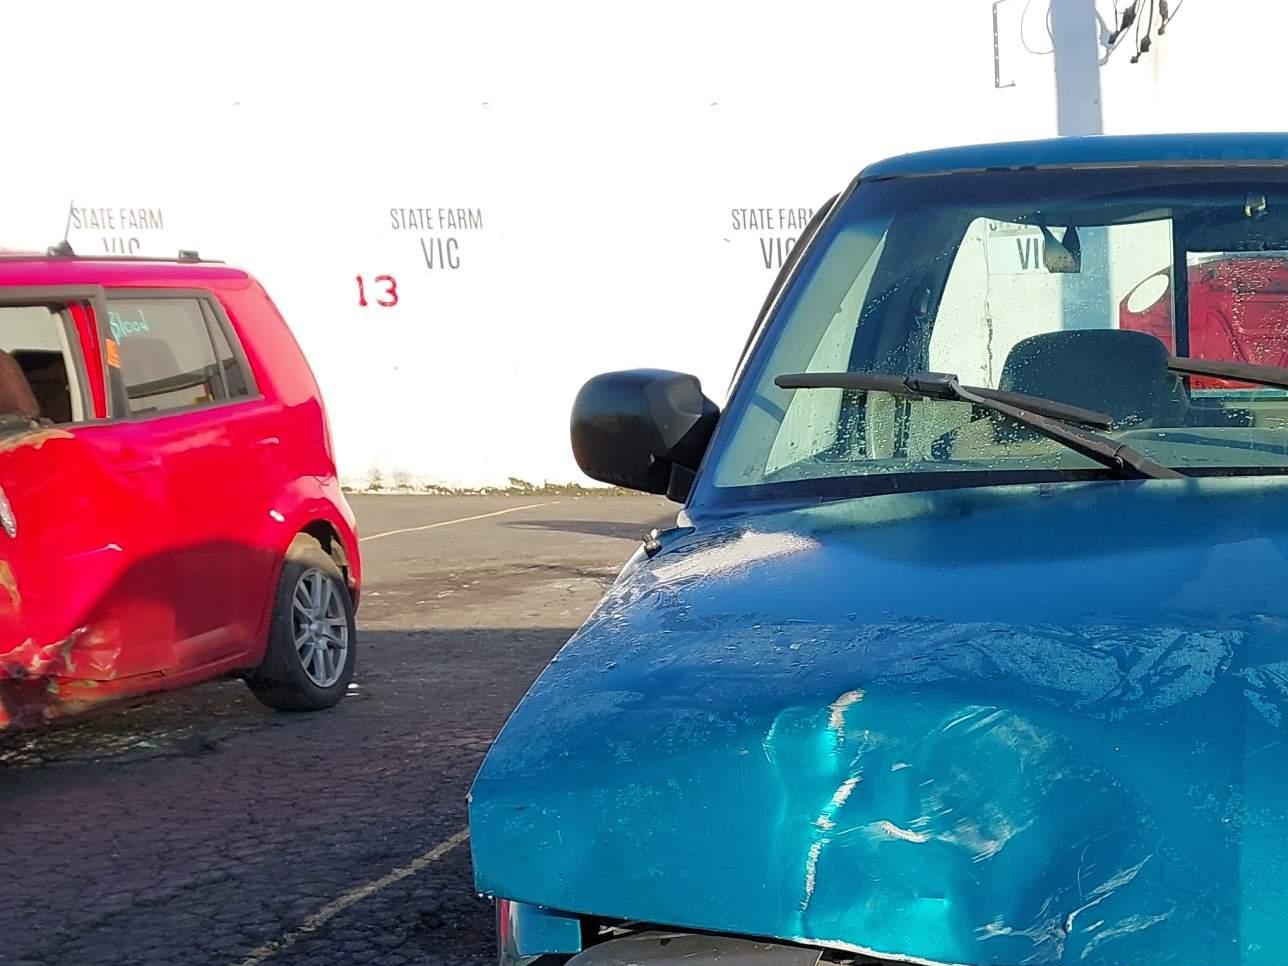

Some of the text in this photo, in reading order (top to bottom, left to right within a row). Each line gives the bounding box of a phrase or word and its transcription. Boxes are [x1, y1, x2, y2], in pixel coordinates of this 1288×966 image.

[71, 207, 164, 230] STATE FARM
[389, 207, 483, 230] STATE FARM
[731, 207, 775, 231] STATE
[420, 237, 460, 270] VIC
[356, 274, 399, 307] 13
